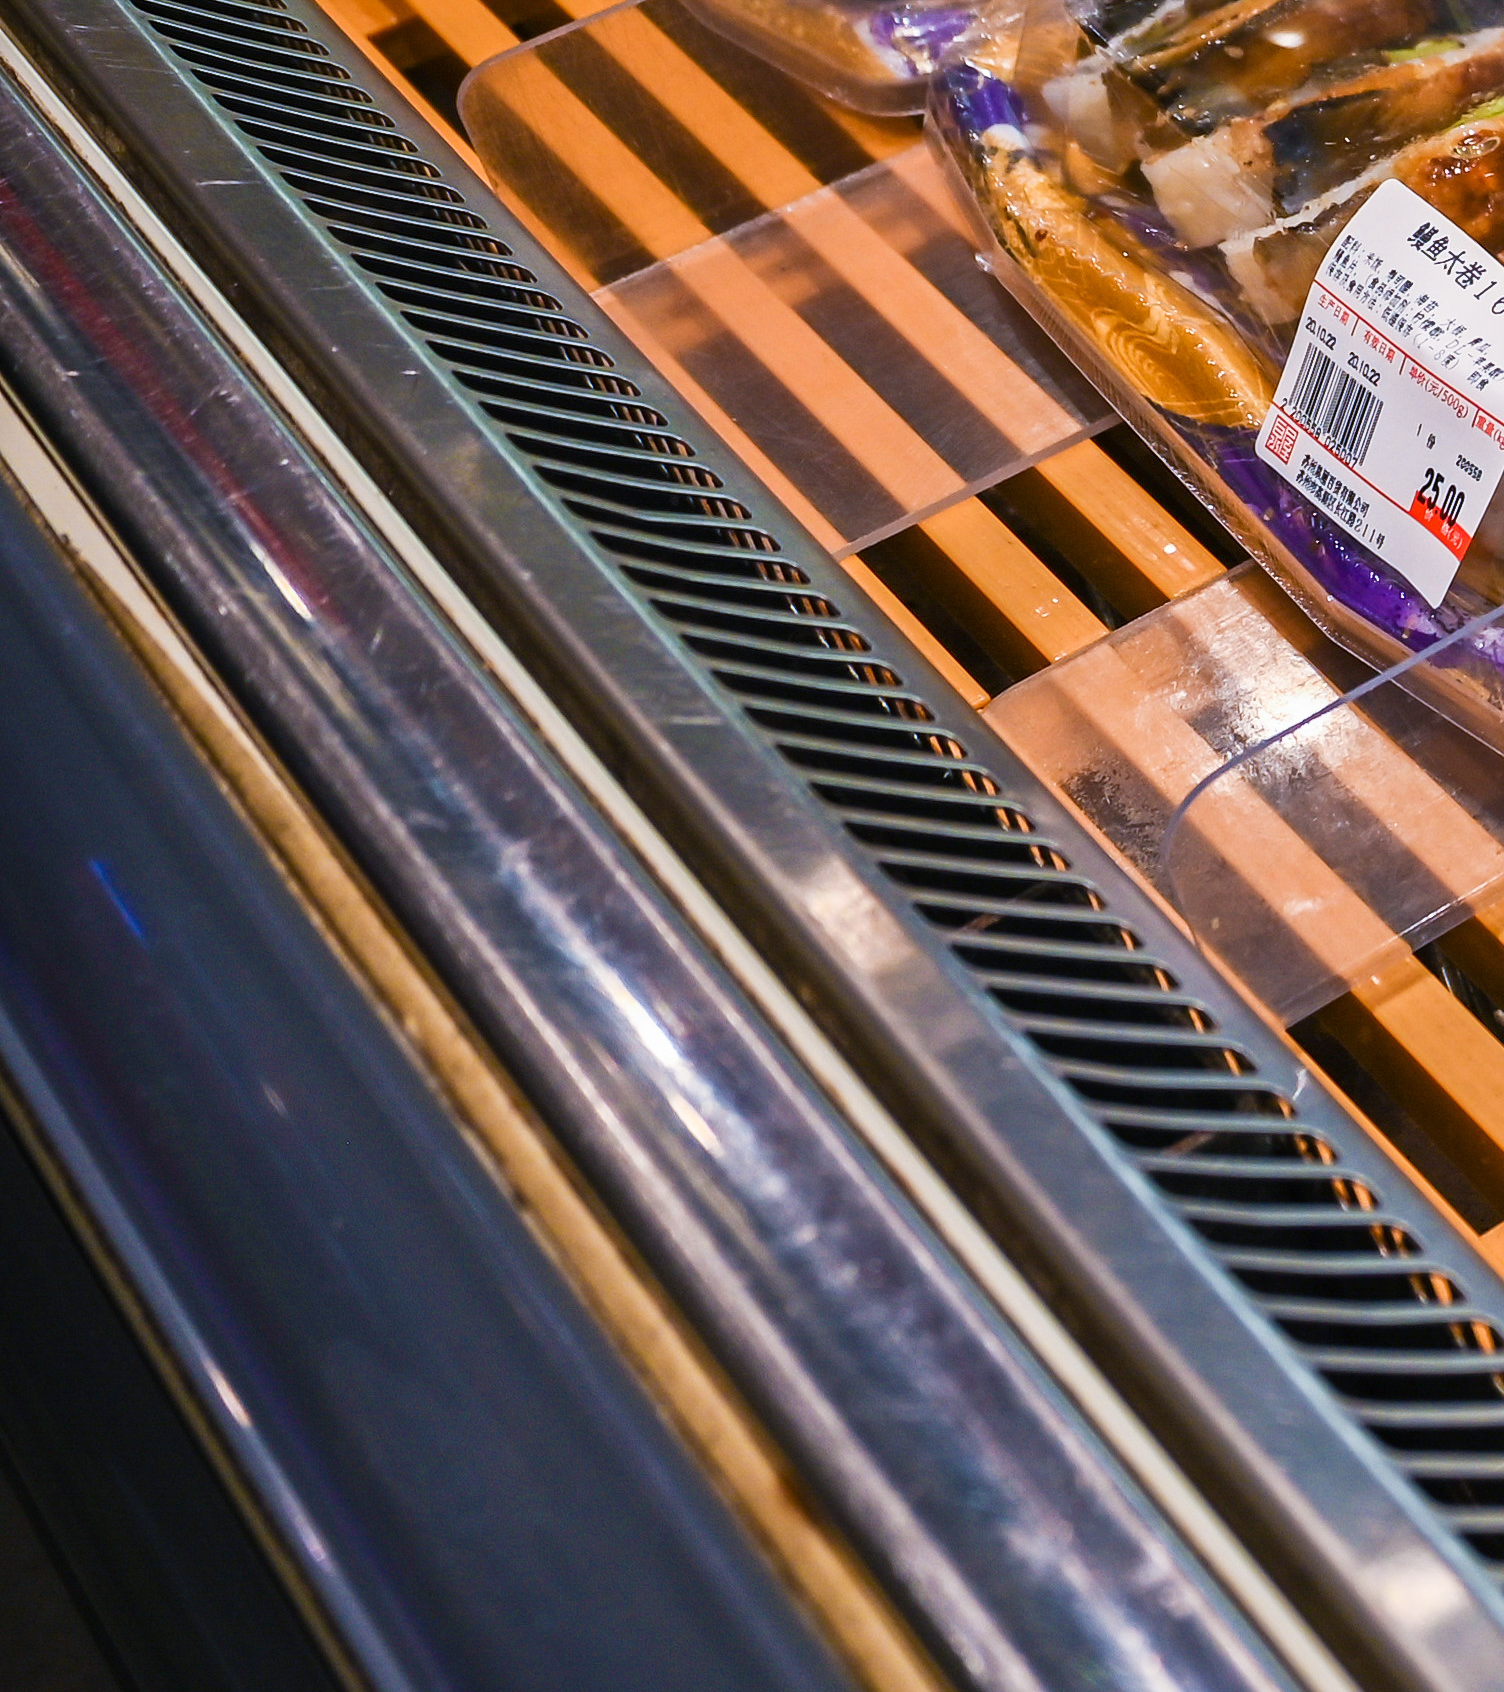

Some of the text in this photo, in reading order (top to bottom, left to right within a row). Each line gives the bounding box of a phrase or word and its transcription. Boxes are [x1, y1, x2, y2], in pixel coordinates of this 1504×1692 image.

[1305, 316, 1381, 386] 20.10.22 20.10.22
[1318, 293, 1350, 326] 生产日期
[1363, 329, 1395, 364] 有效日期
[1408, 365, 1470, 419] 单价(元/500g)
[1281, 397, 1358, 467] 2 200558 025007
[1417, 424, 1482, 482] 1 份 200558
[1417, 468, 1465, 527] 25.00
